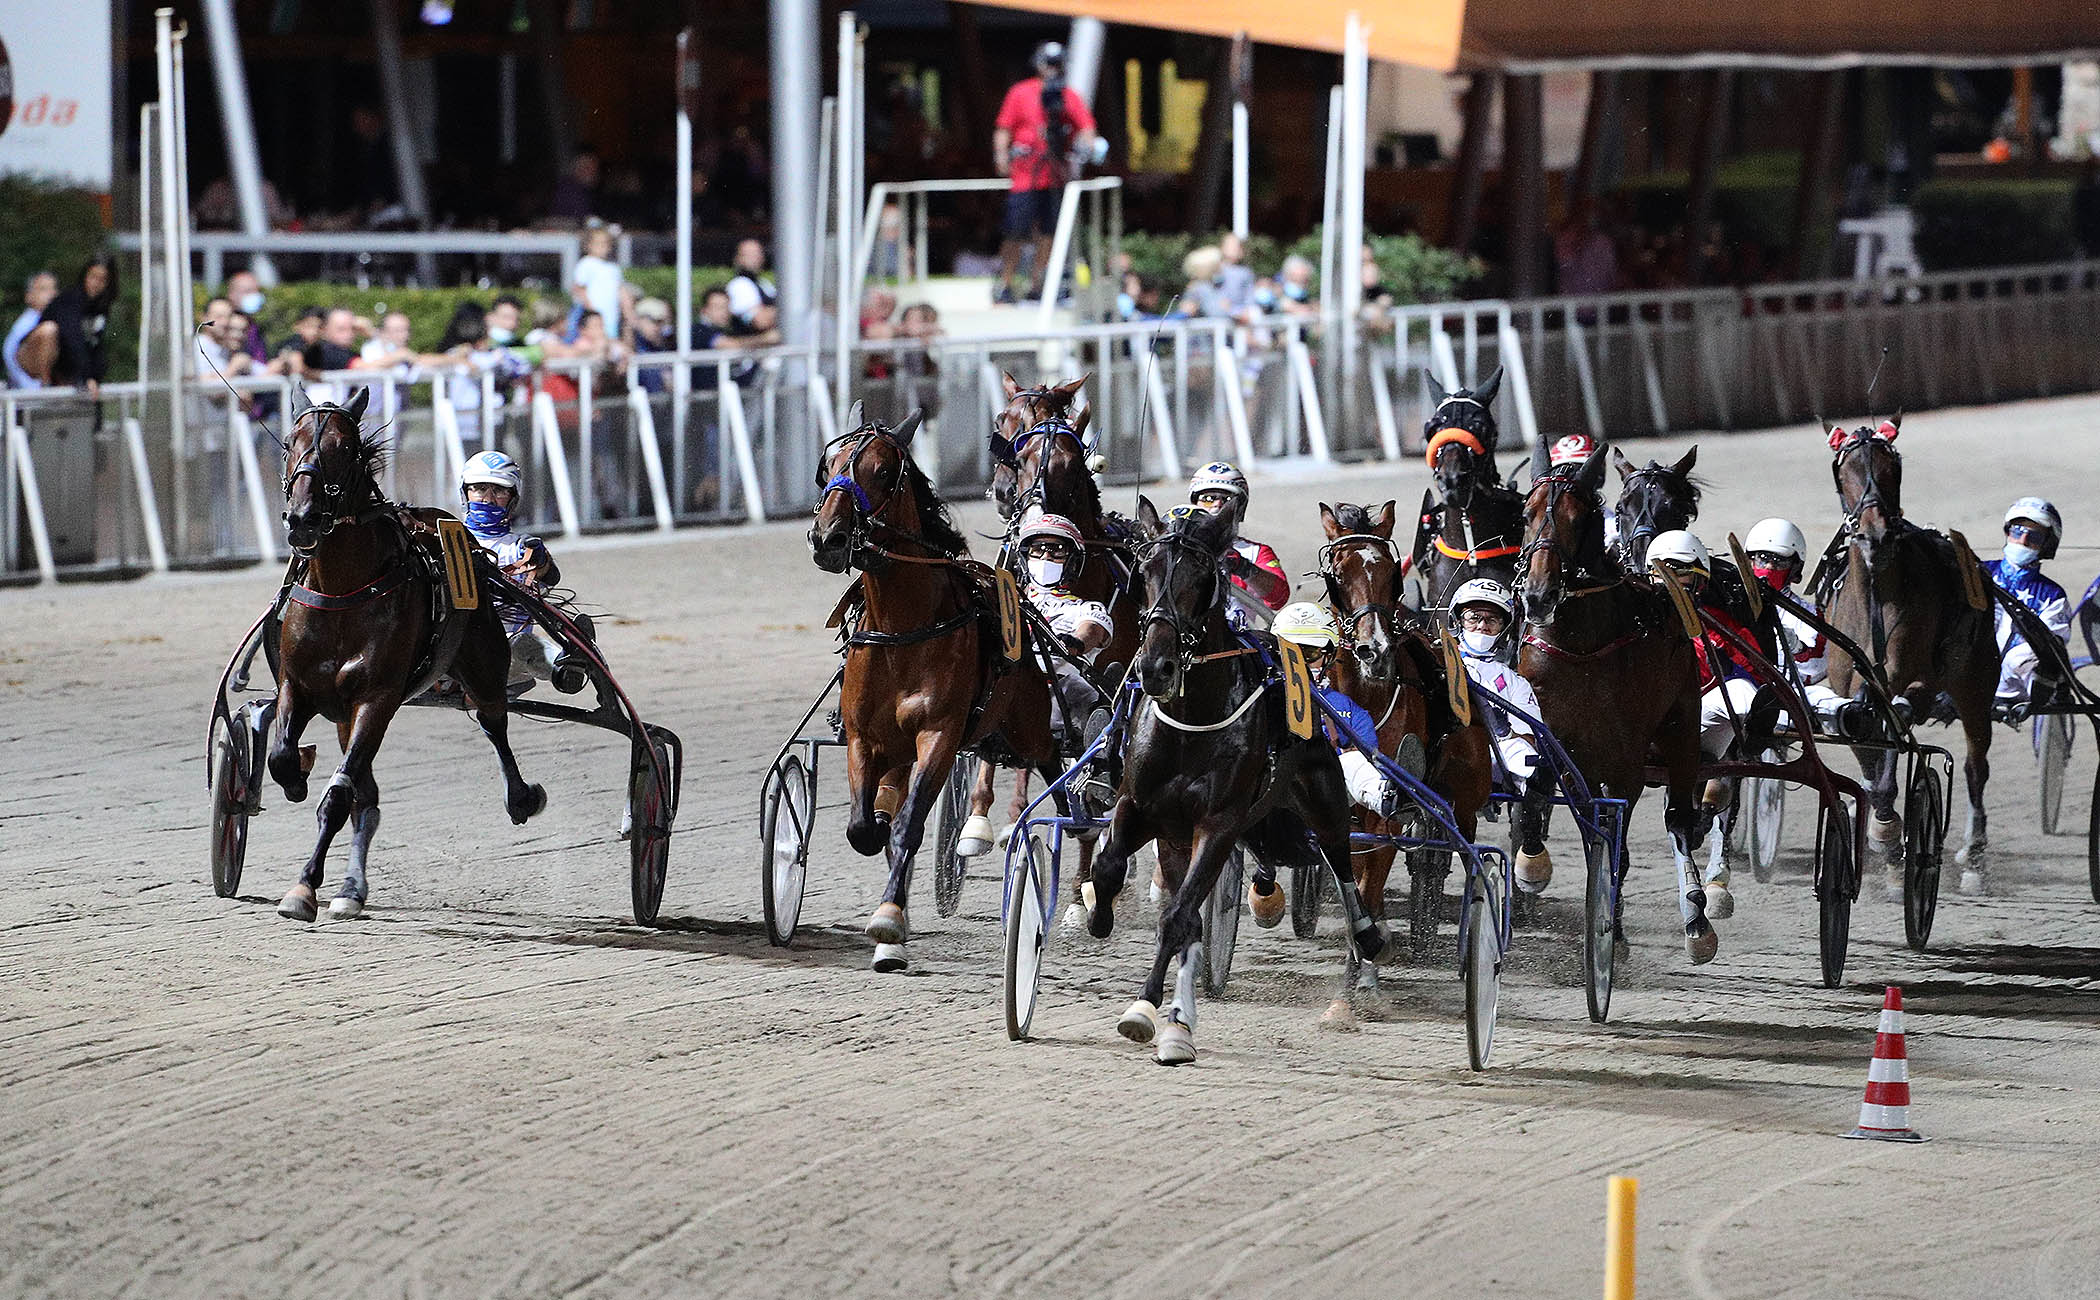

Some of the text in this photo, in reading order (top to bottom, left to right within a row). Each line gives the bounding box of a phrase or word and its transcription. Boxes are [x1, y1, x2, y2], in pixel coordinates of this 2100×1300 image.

[1003, 577, 1017, 649] 9
[1286, 647, 1305, 723] 5
[1447, 637, 1465, 712] 2
